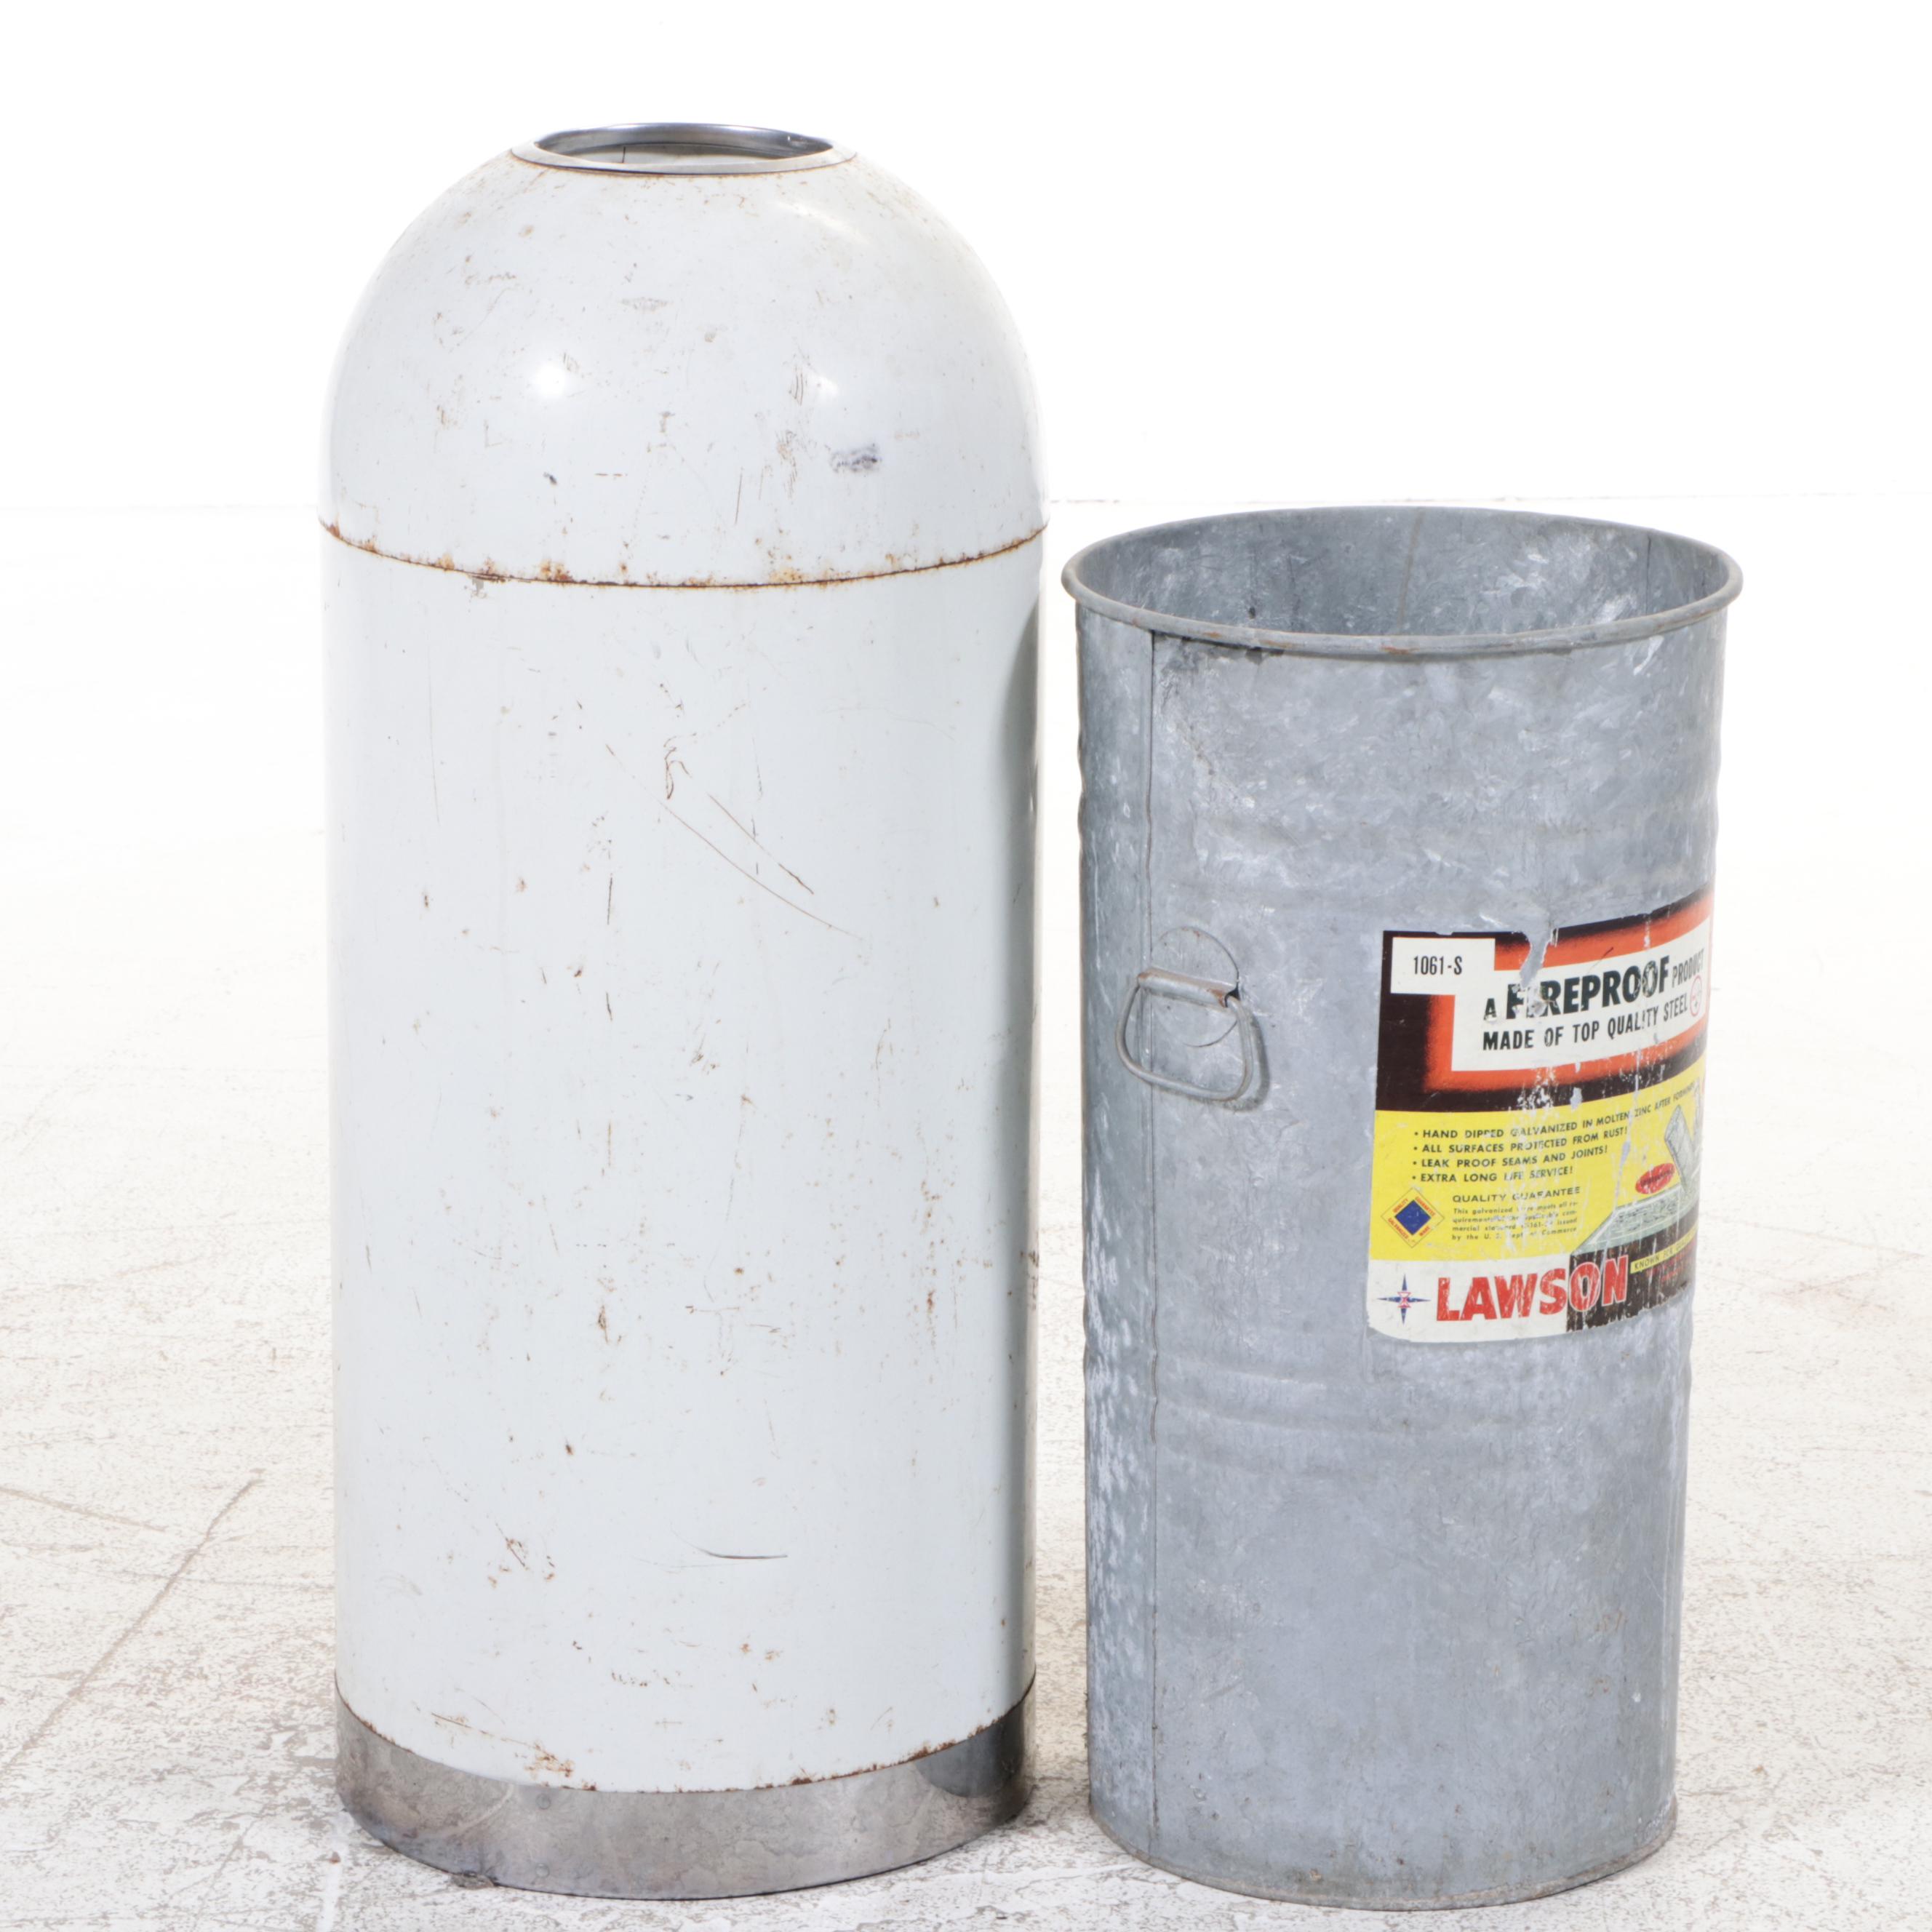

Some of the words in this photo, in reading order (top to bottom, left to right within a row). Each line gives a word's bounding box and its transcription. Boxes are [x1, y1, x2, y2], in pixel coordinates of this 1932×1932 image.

[1413, 956, 1463, 975] 1061-S
[1483, 998, 1497, 1021] A
[1506, 955, 1670, 1021] FREPROOF
[1672, 948, 1705, 989] PRODUCT
[1482, 1030, 1534, 1051] MADE
[1544, 1026, 1564, 1047] OF
[1573, 1021, 1600, 1043] TOP
[1608, 1005, 1659, 1039] QUALITY
[1664, 992, 1688, 1021] STEEL
[1422, 1129, 1458, 1138] HAND
[1510, 1122, 1577, 1137] GALVANIZED
[1582, 1119, 1593, 1129] IN
[1596, 1111, 1629, 1126] MOLTEN
[1634, 1104, 1652, 1117] ZINC
[1422, 1144, 1442, 1153] ALL
[1448, 1143, 1504, 1153] SURFACES
[1510, 1138, 1567, 1151] PROTECTED
[1573, 1133, 1599, 1145] FROM
[1603, 1126, 1628, 1139] RUST!
[1421, 1159, 1450, 1167] LEAK
[1456, 1159, 1496, 1167] PROOF
[1502, 1155, 1538, 1166] SEAMS
[1543, 1152, 1565, 1163] AND
[1571, 1145, 1608, 1159] JOINTS!
[1421, 1173, 1457, 1182] EXTRA
[1464, 1173, 1497, 1182] LONG
[1529, 1165, 1573, 1179] SERVICE!
[1452, 1194, 1507, 1202] QUALITY
[1451, 1233, 1461, 1241] by
[1634, 1253, 1659, 1271] KNOWN
[1437, 1256, 1629, 1322] LAWSON
